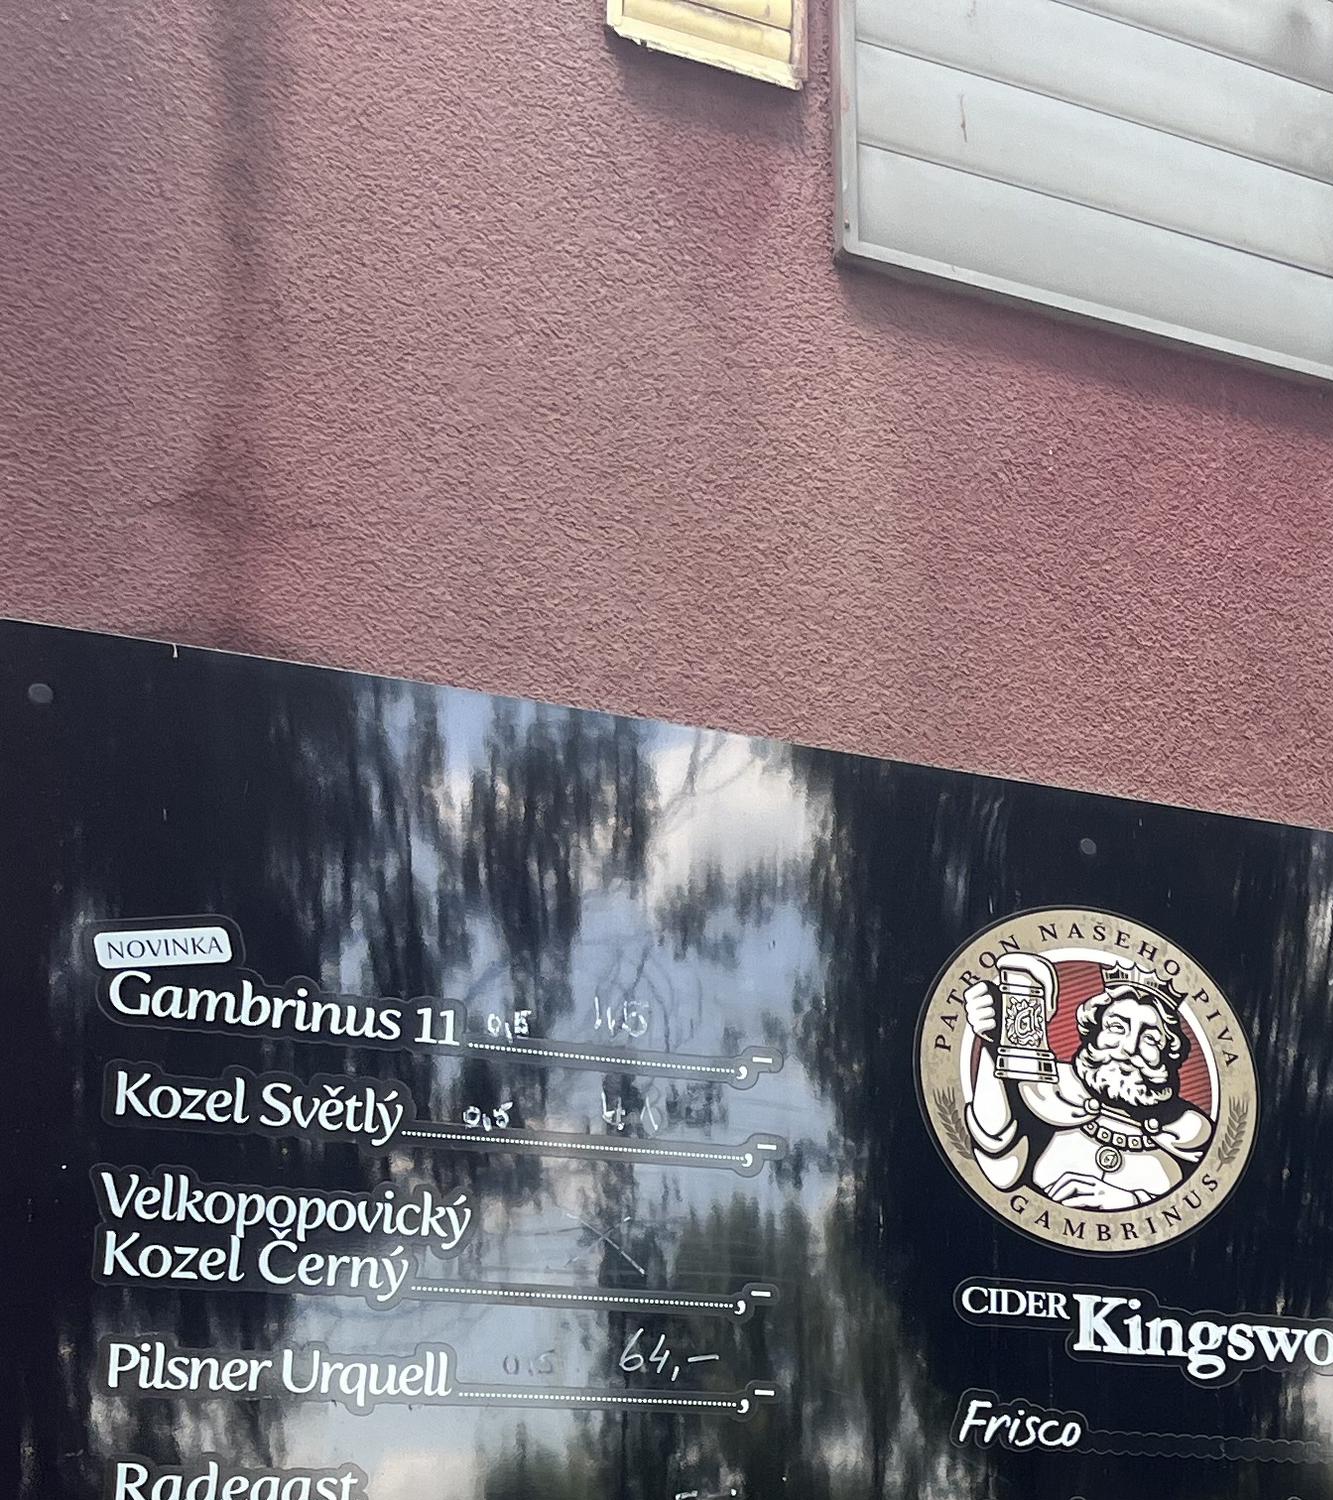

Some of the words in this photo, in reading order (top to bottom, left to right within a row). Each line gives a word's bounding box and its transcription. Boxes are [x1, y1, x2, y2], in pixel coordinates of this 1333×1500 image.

[106, 936, 225, 961] NOVINKA
[109, 969, 401, 1042] Gambrinus
[414, 1007, 461, 1047] 11
[936, 935, 1021, 1052] PATRON
[1041, 921, 1182, 979] NAŠEHO
[1192, 988, 1240, 1068] PIVA
[115, 1071, 249, 1125] Kozel
[260, 1081, 405, 1148] Světlý
[101, 1172, 471, 1248] Velkopopovický
[1010, 1172, 1219, 1243] GAMBRINUS
[103, 1231, 245, 1282] Kozel
[259, 1230, 409, 1300] Černý
[961, 1285, 1071, 1322] CIDER
[107, 1343, 275, 1393] Pilsner
[283, 1351, 453, 1407] Urquell
[618, 1328, 720, 1382] 64,-
[960, 1399, 1082, 1449] Frisco
